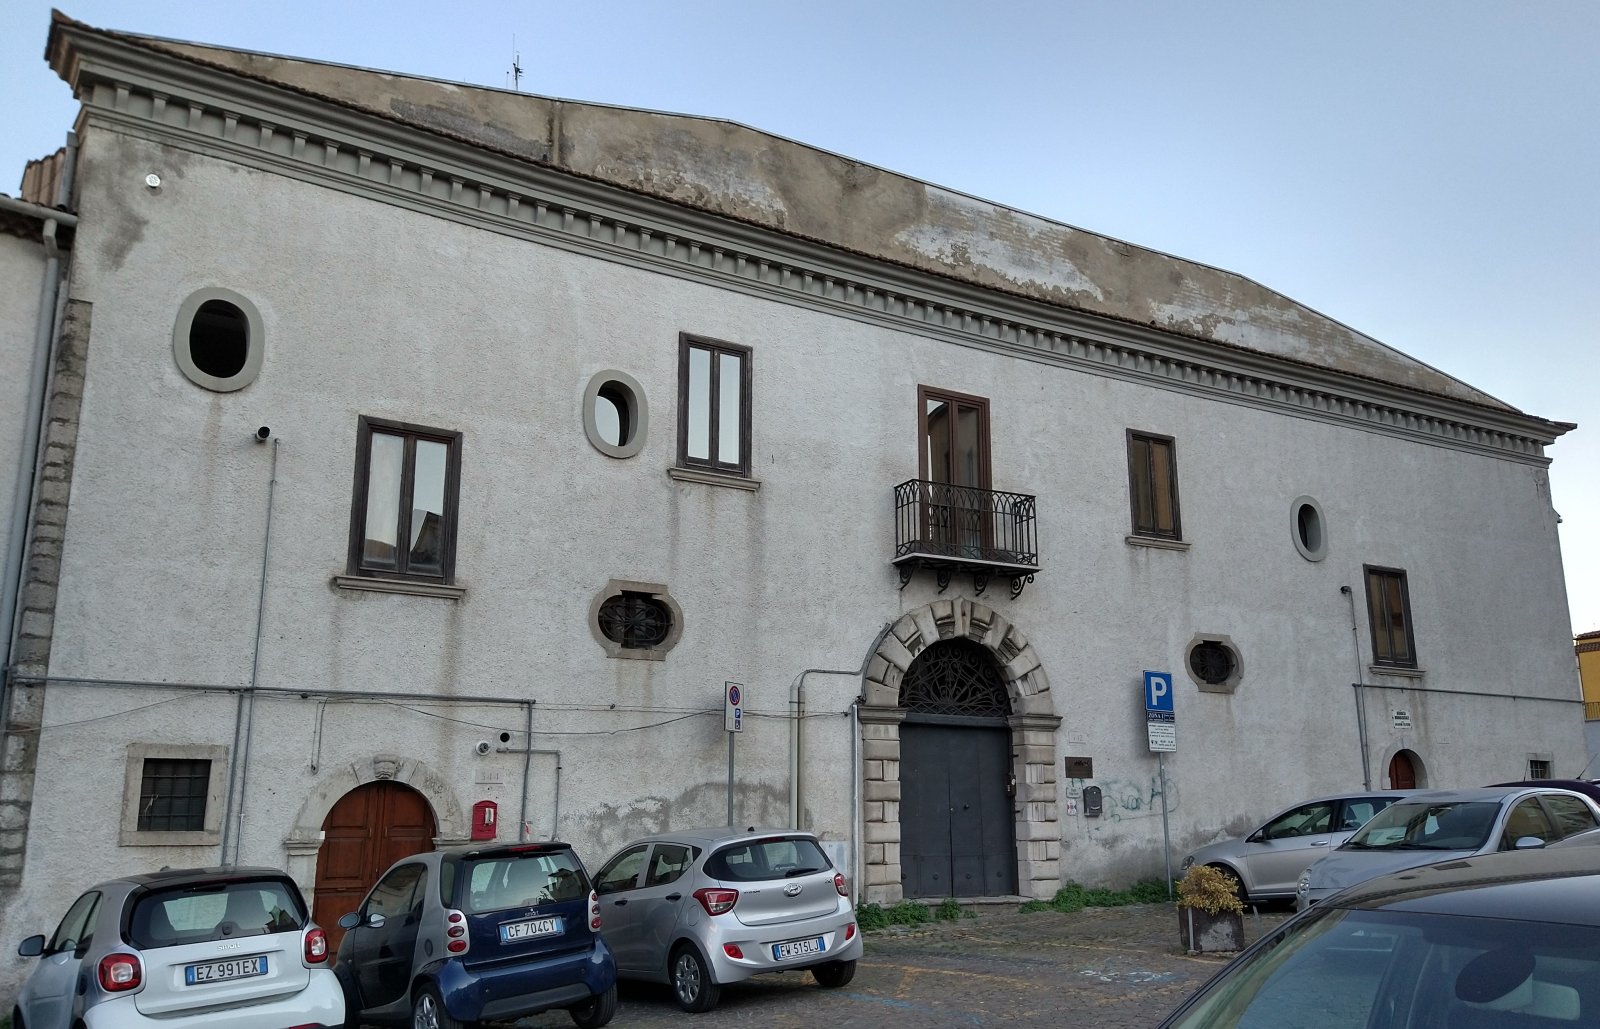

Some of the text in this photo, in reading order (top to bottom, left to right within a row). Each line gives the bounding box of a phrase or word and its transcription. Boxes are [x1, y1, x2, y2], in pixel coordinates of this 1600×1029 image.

[1150, 676, 1167, 706] P
[508, 919, 555, 938] CF 704CY
[793, 939, 819, 955] 515LJ
[196, 959, 259, 981] EZ 991EX
